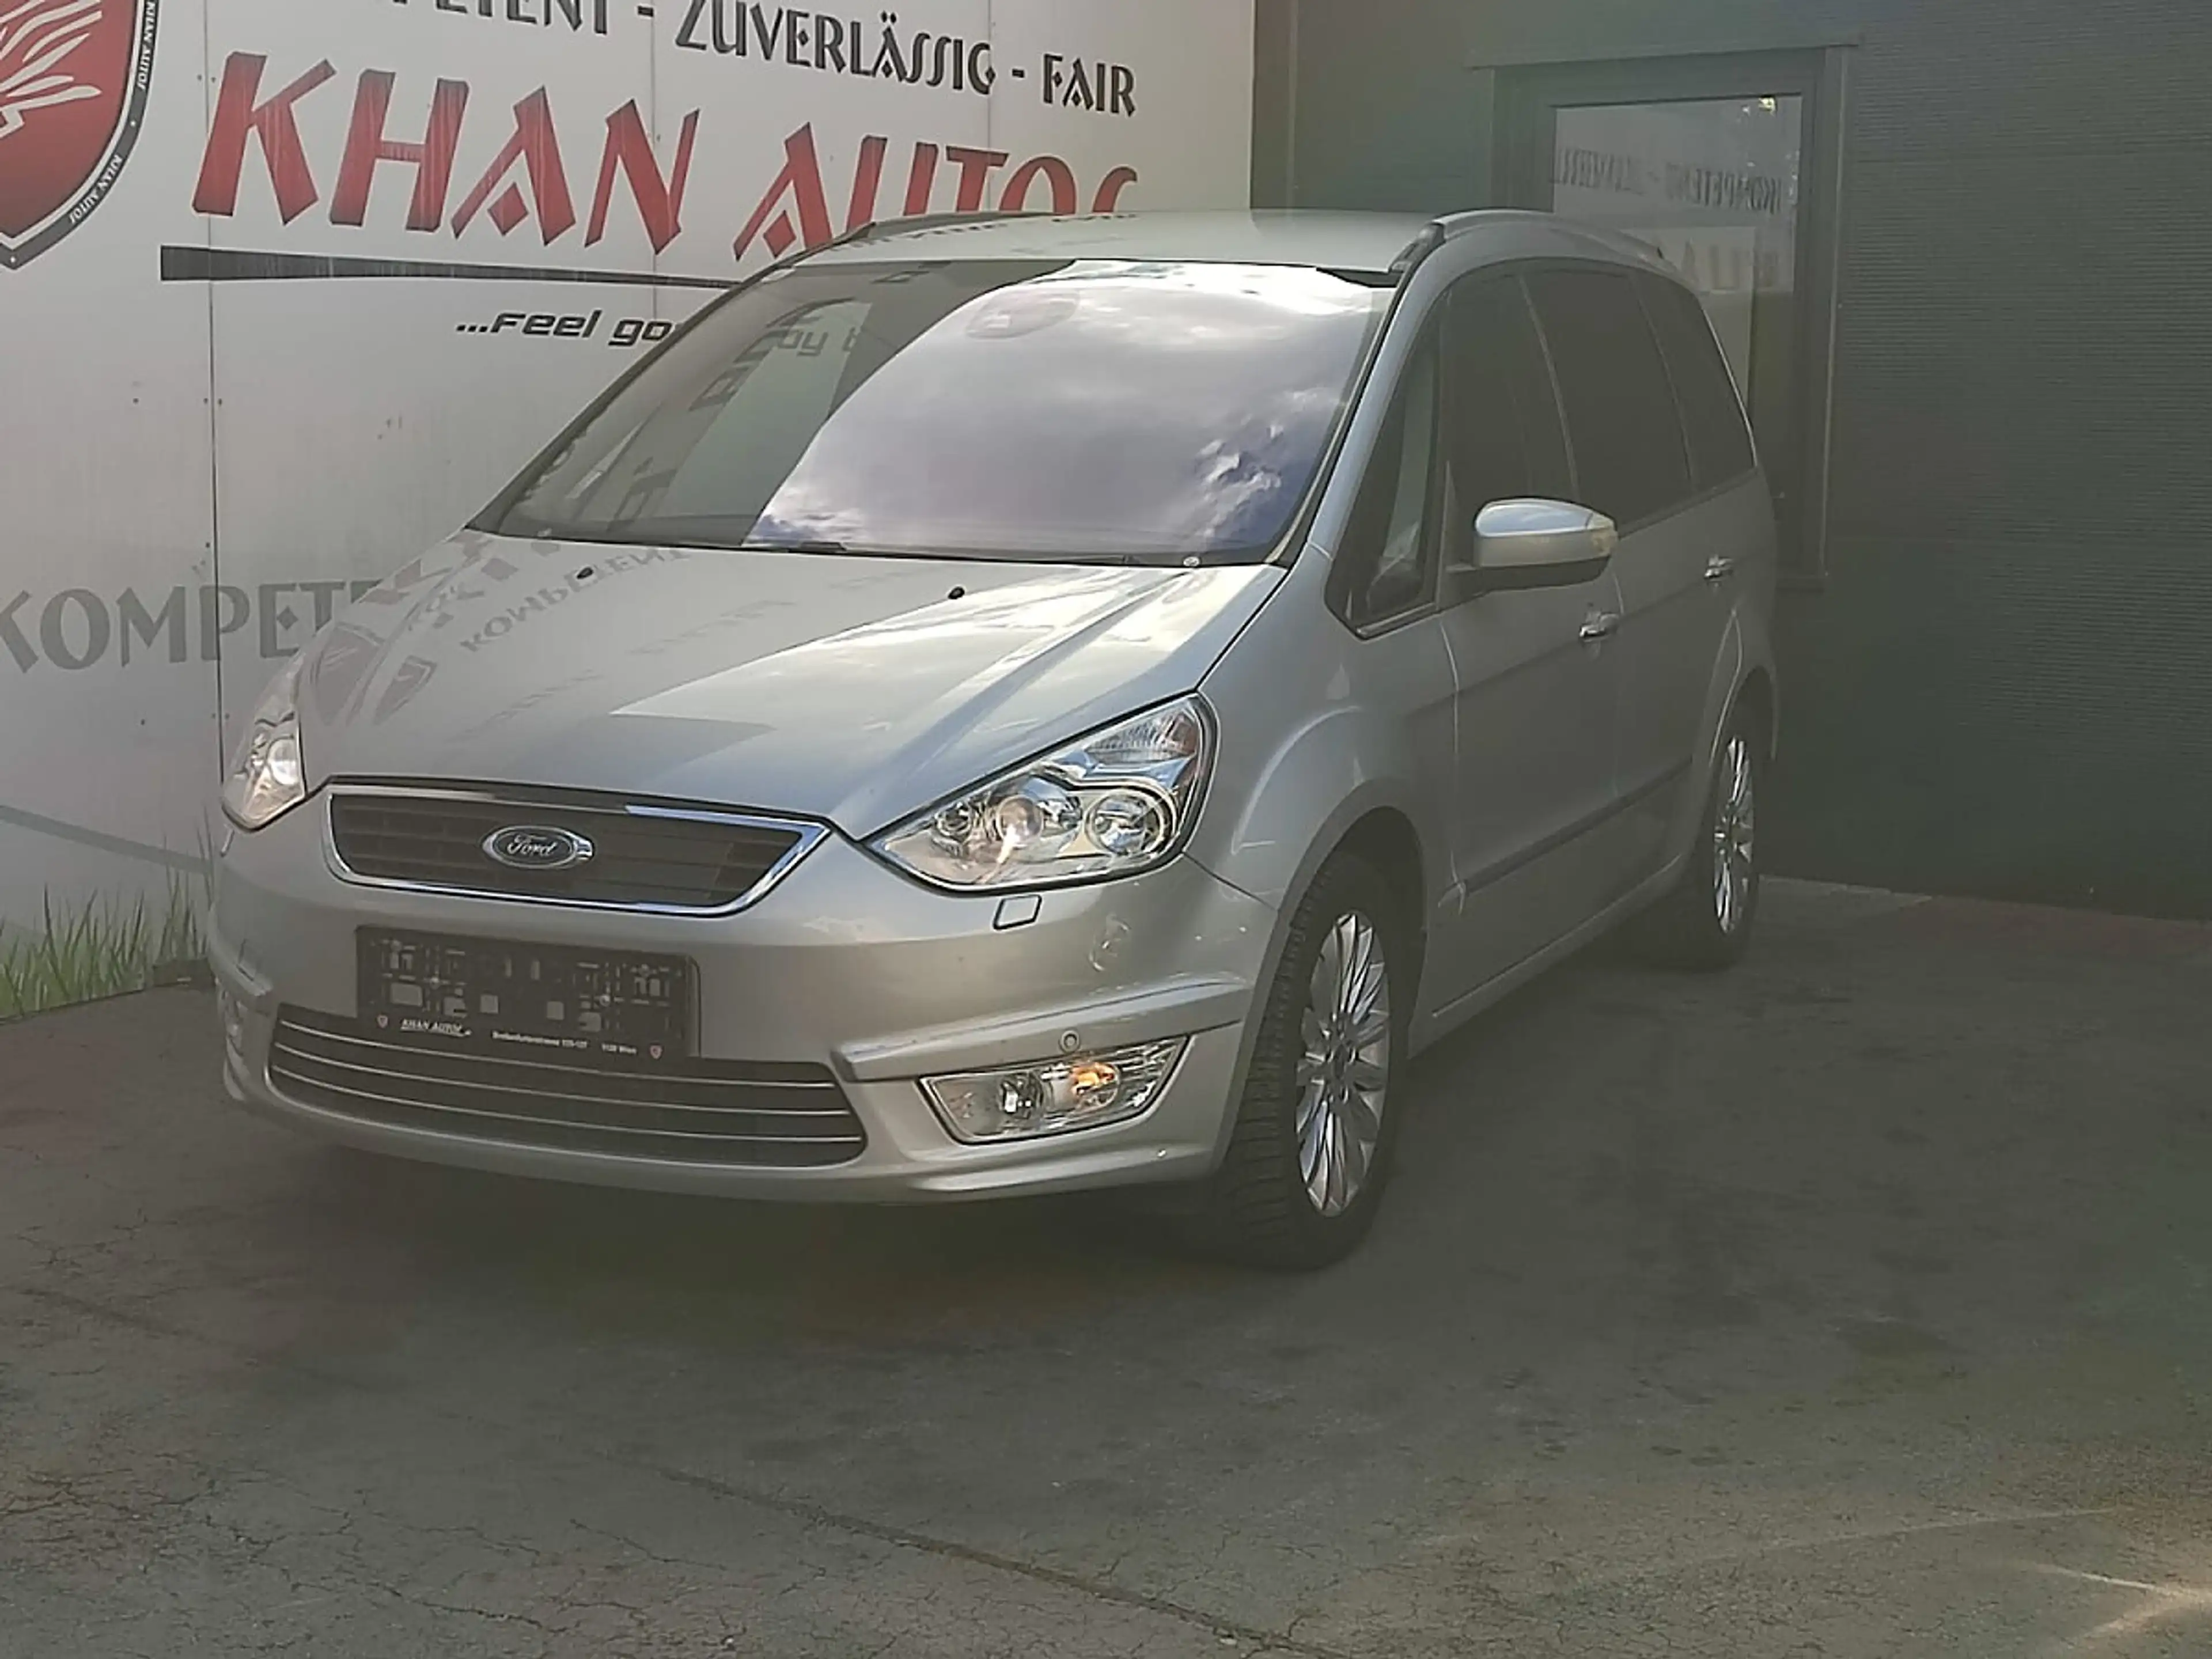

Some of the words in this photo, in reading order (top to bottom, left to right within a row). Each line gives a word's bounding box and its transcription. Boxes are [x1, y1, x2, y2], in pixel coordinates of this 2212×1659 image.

[675, 0, 995, 95] ZUVERLÄSSIG
[1043, 54, 1136, 118] FAIR
[192, 51, 700, 255] KHAN
[608, 319, 679, 346] go
[0, 581, 382, 674] KOMPET
[506, 835, 559, 858] Ford
